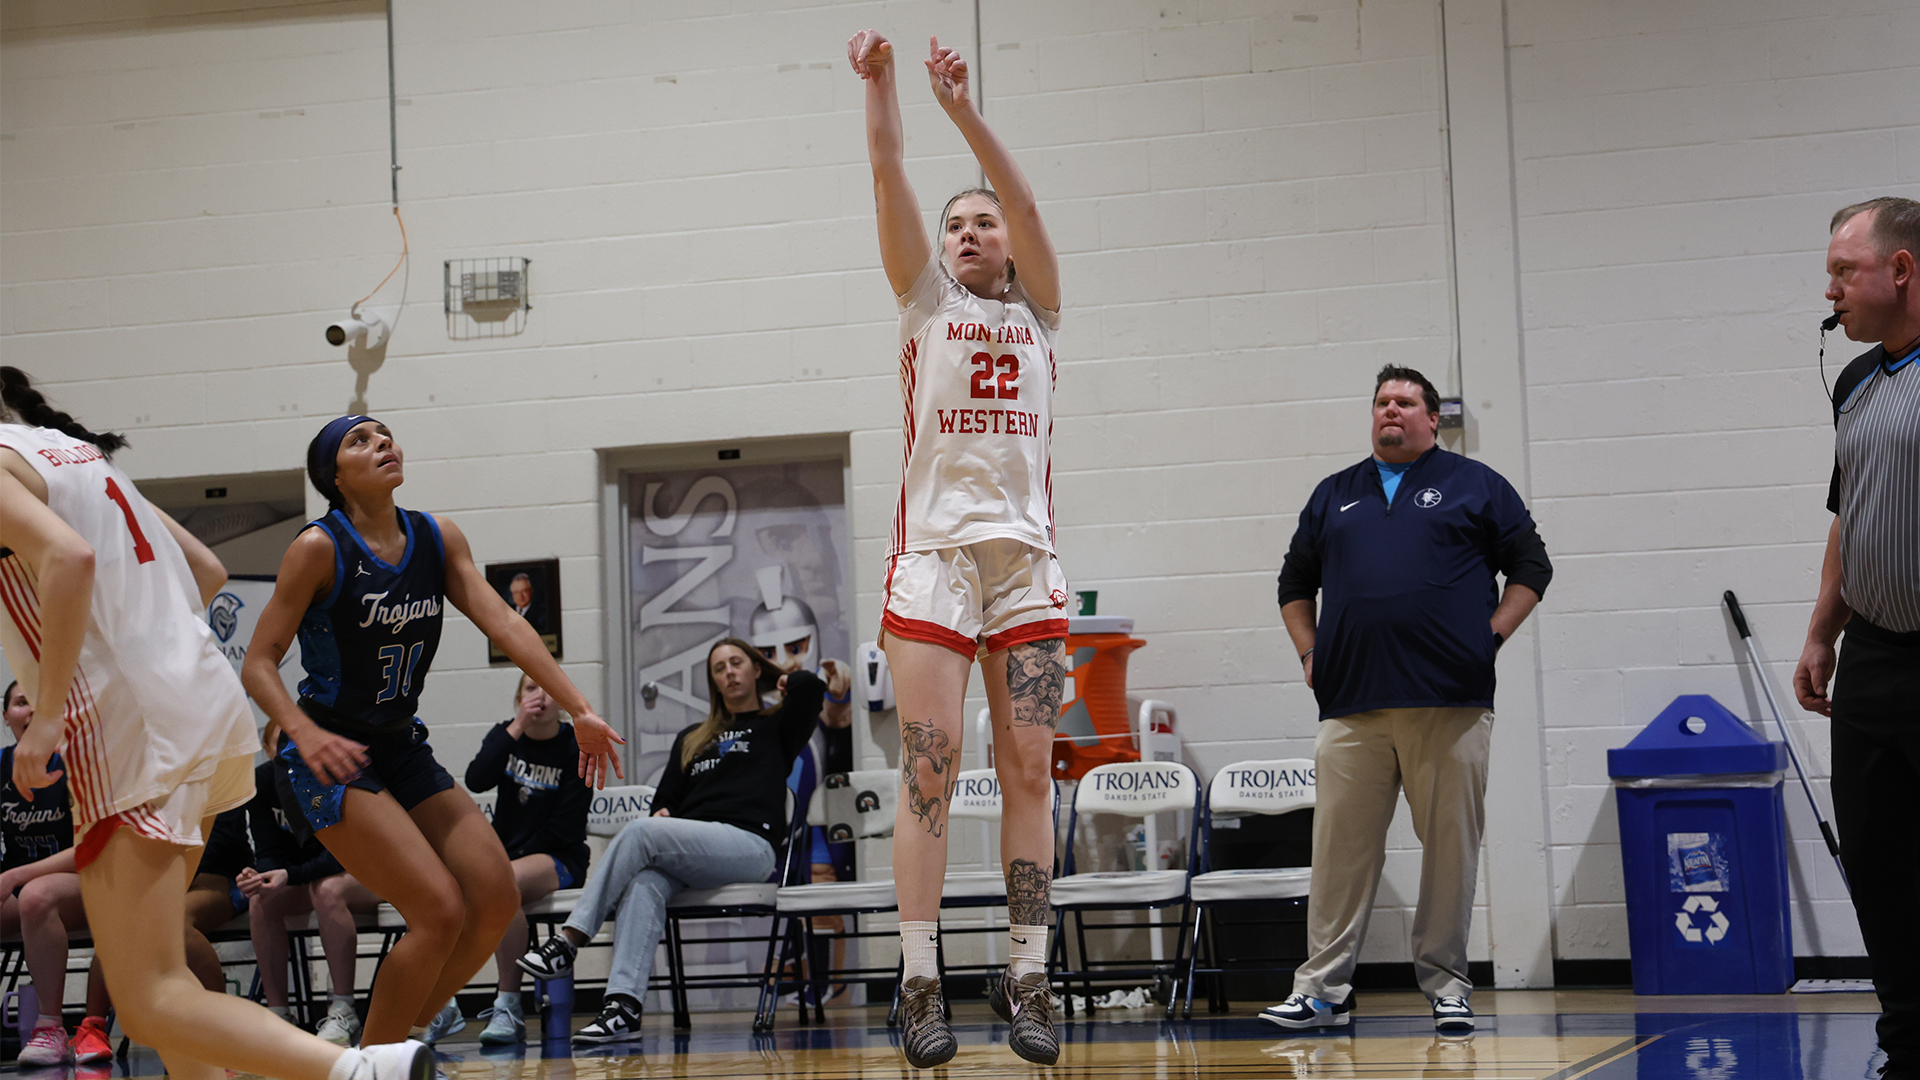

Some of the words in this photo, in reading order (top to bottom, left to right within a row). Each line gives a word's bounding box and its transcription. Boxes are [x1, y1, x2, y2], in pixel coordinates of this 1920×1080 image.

[947, 322, 1035, 345] MONTANA
[970, 352, 1019, 400] 22
[937, 409, 1039, 438] WESTERN
[37, 444, 104, 467] BULLDO
[105, 476, 155, 565] 1
[359, 590, 441, 634] Trojans
[375, 640, 424, 704] 31
[954, 778, 1002, 798] TROJ
[1093, 770, 1180, 792] TROJANS
[1227, 768, 1316, 790] TROJANS
[1104, 793, 1137, 801] DAKOTA
[1142, 791, 1167, 801] STATE
[1278, 789, 1304, 798] STATE
[1, 802, 66, 831] Trojans
